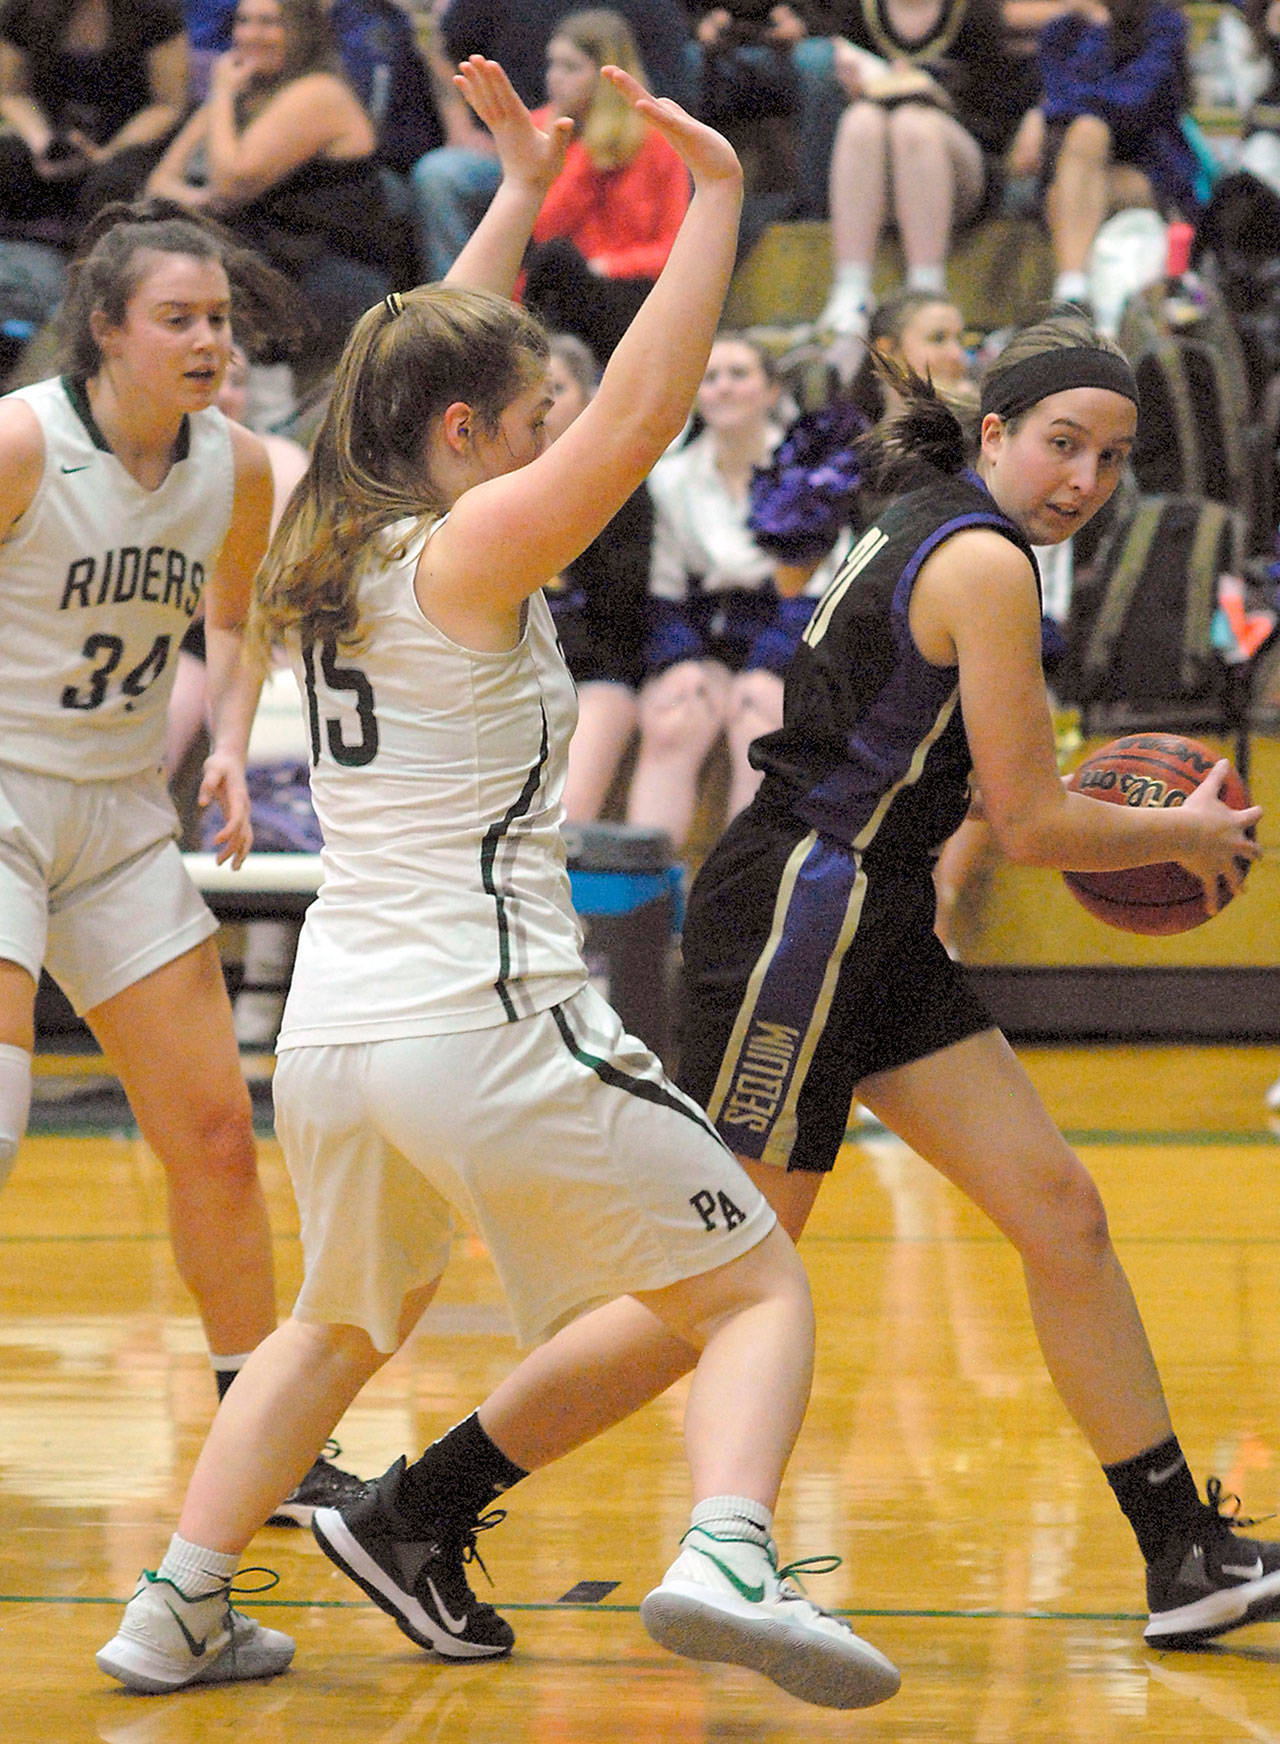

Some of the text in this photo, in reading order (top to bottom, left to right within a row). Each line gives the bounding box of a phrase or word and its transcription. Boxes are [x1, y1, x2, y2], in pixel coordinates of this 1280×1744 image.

[59, 545, 204, 616] RIDERS
[61, 632, 172, 711] 34
[302, 613, 380, 767] 15
[724, 1019, 800, 1133] SEQUIM
[689, 1189, 747, 1232] PA
